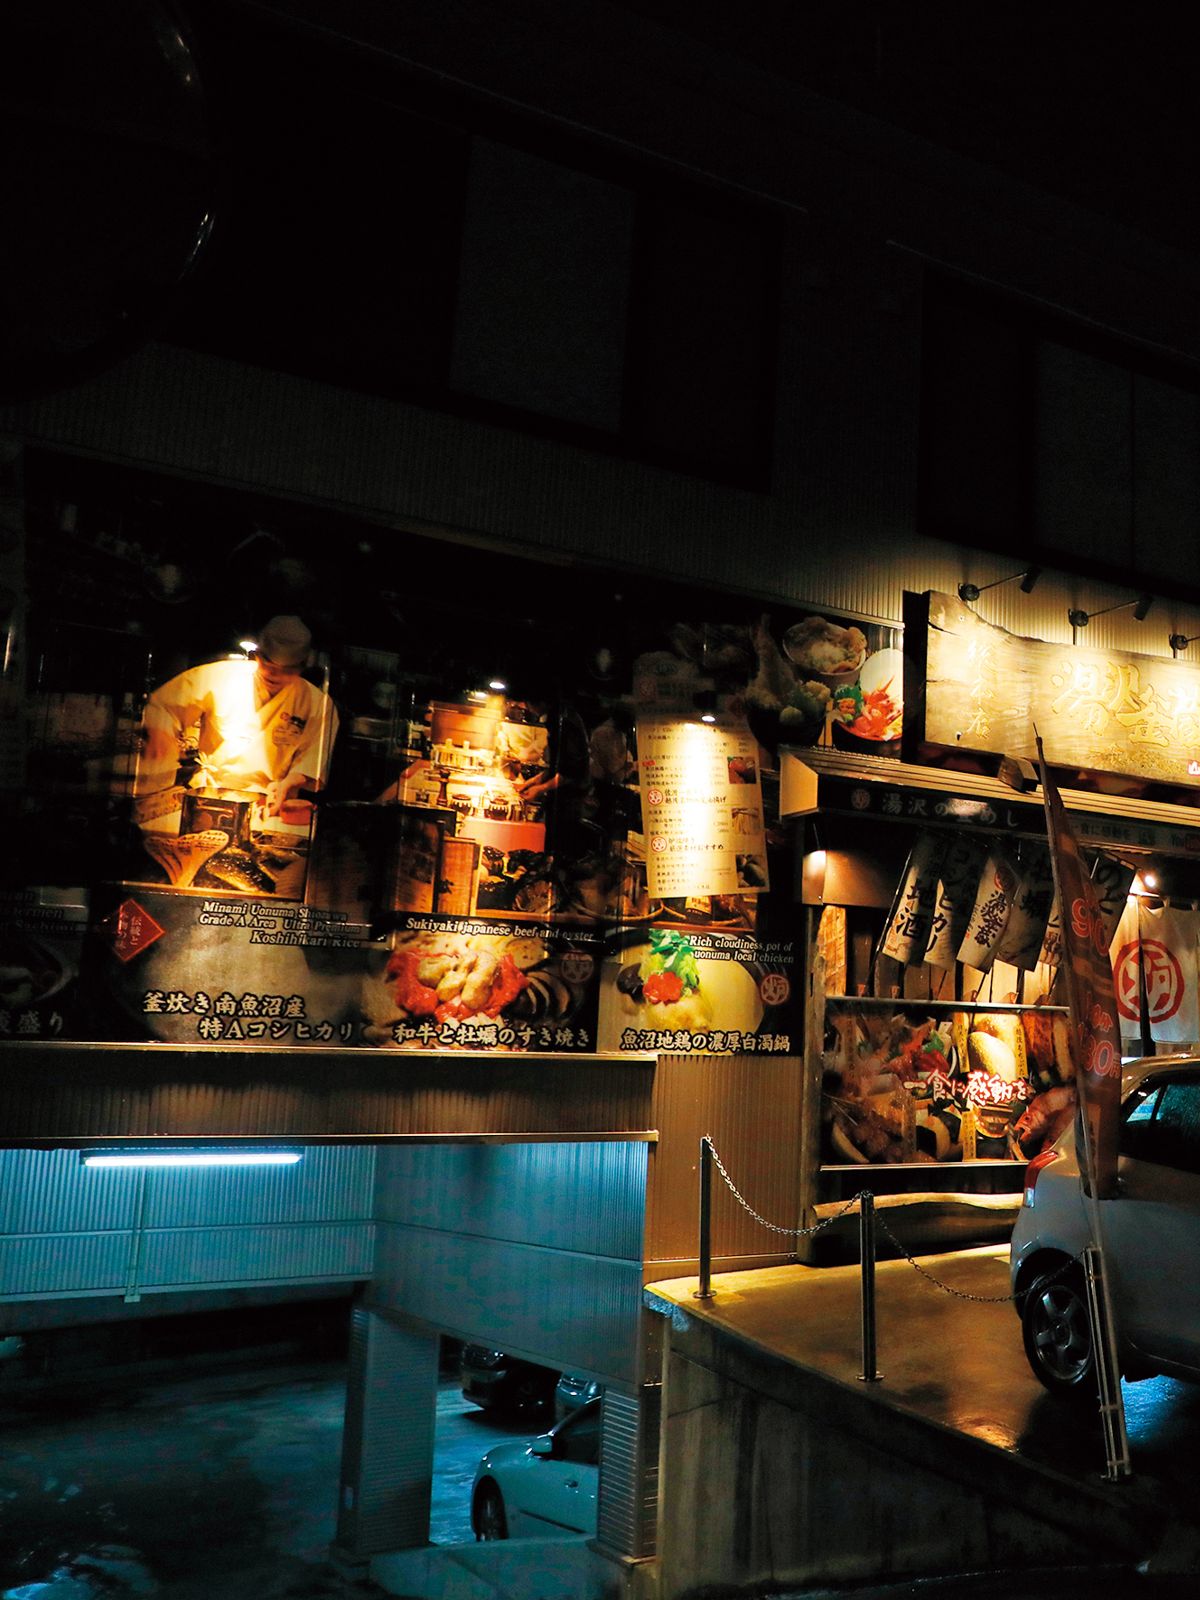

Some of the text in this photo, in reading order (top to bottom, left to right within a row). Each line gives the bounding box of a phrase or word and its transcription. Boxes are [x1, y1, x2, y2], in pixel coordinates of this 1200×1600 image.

[202, 900, 248, 914] Minami
[199, 913, 233, 926] Grade
[236, 917, 246, 927] A
[249, 917, 277, 929] Area
[283, 918, 312, 931] Ultra
[250, 930, 361, 949] Koshihikari Rice
[689, 935, 712, 947] Rich
[766, 942, 781, 953] pot
[783, 941, 794, 951] of
[733, 950, 757, 962] local
[758, 953, 795, 964] chicken
[142, 991, 306, 1018] 釜炊き南魚沼産
[198, 1020, 354, 1041] 特Aコシヒカリ
[393, 1023, 591, 1048] 和牛と牡蠣のすき焼き
[903, 1070, 1029, 1107] 一食に感動を
